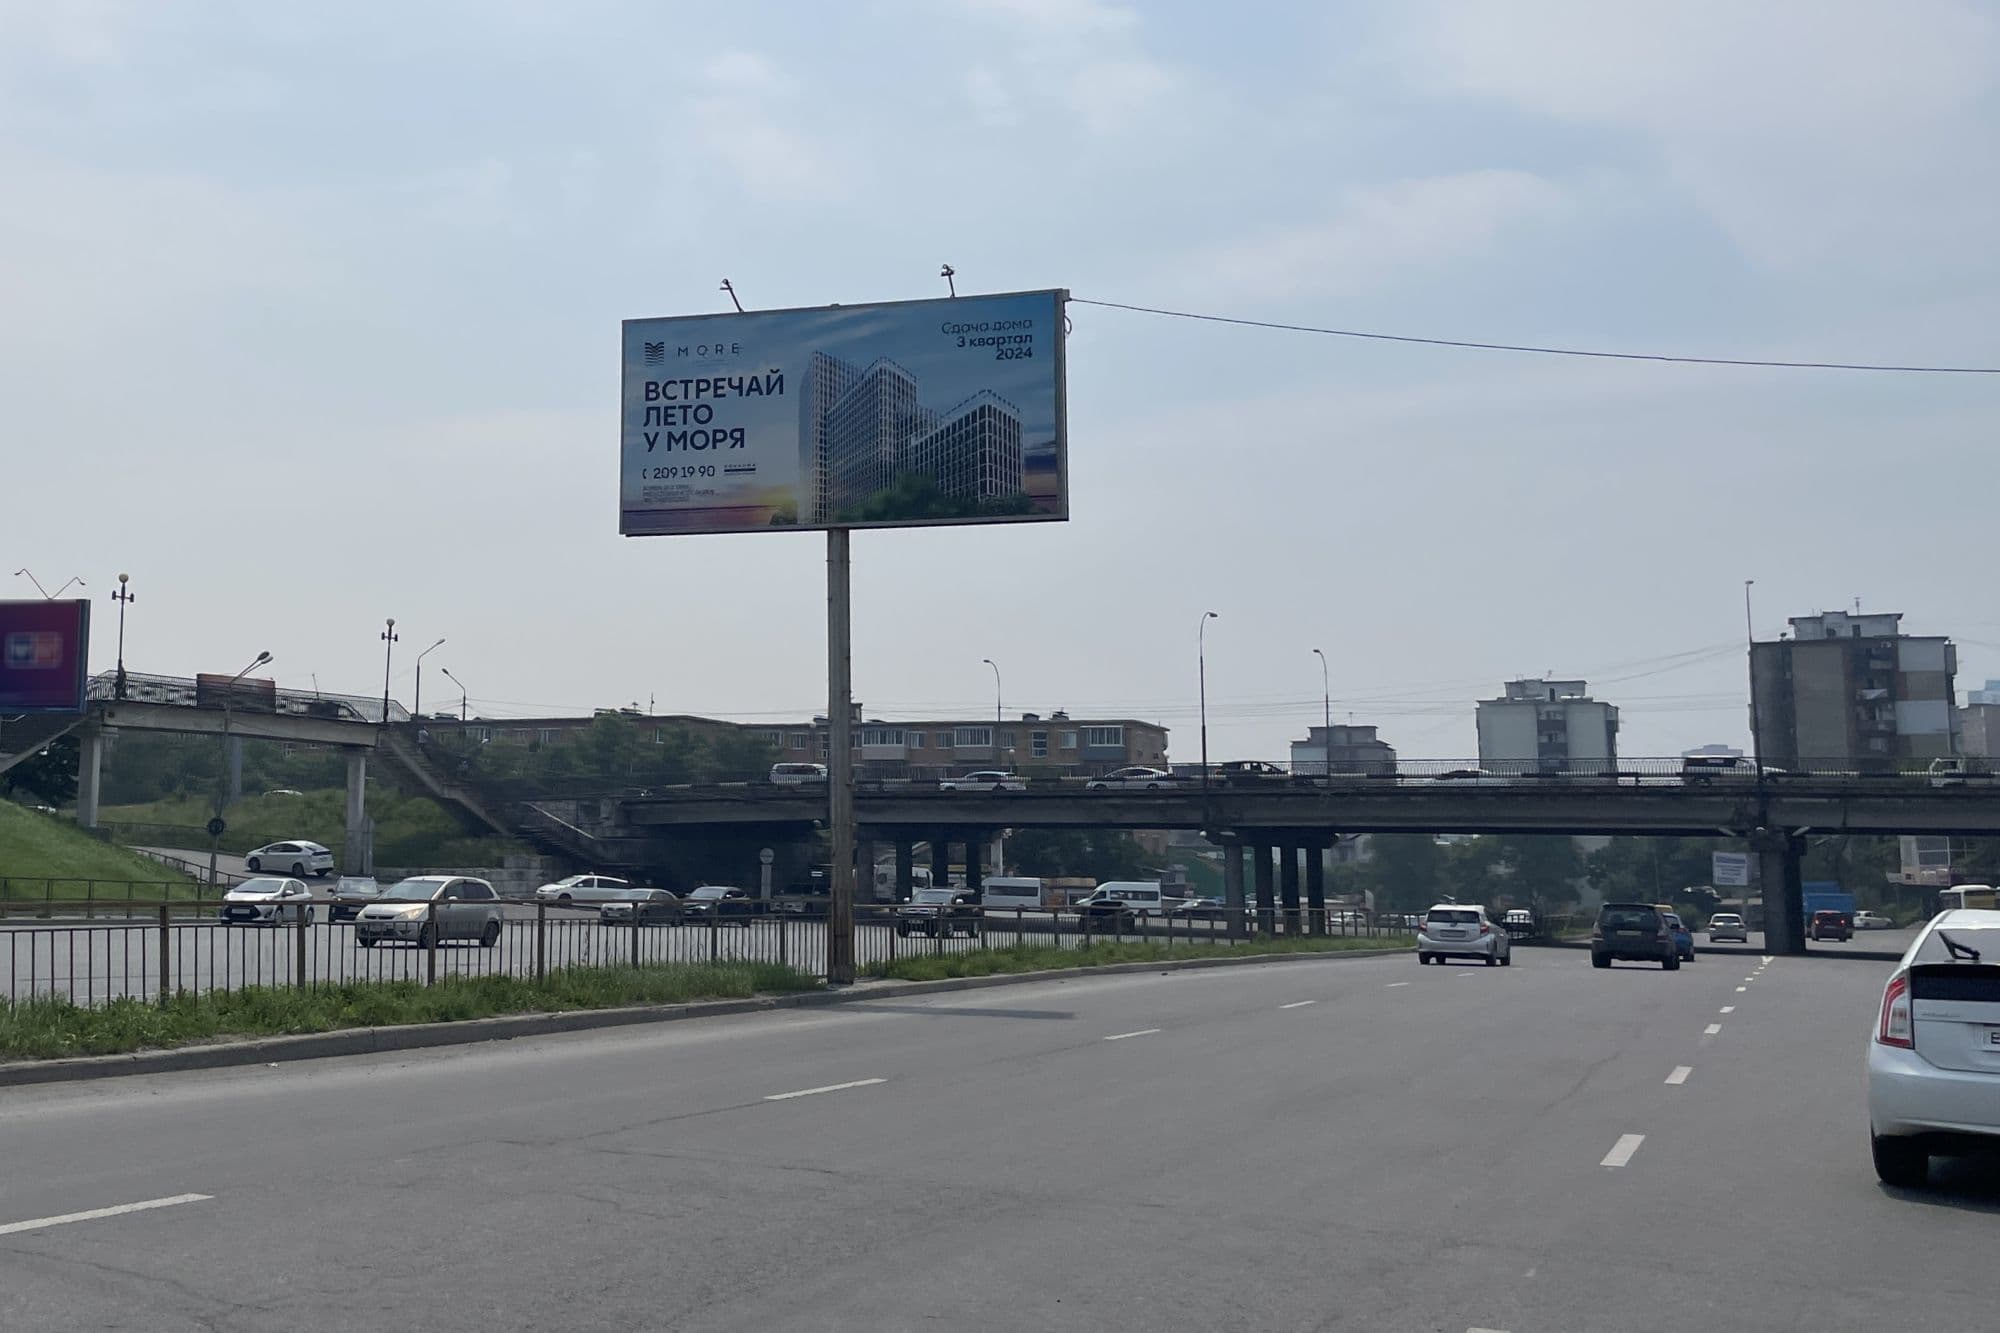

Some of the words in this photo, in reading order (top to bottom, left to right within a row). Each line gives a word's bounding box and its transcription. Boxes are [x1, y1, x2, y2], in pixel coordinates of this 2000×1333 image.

[941, 322, 989, 334] Сдача
[992, 319, 1033, 332] дома
[957, 336, 966, 348] 3
[969, 334, 1033, 349] квартал
[677, 343, 742, 357] MORE
[996, 347, 1033, 360] 2024
[645, 369, 784, 401] ВСТРЕЧАЙ
[643, 404, 713, 427] ЛЕТО
[643, 431, 660, 452] У
[667, 428, 745, 451] МОРЯ
[653, 467, 678, 479] 209
[681, 466, 695, 478] 19
[698, 465, 715, 477] 90
